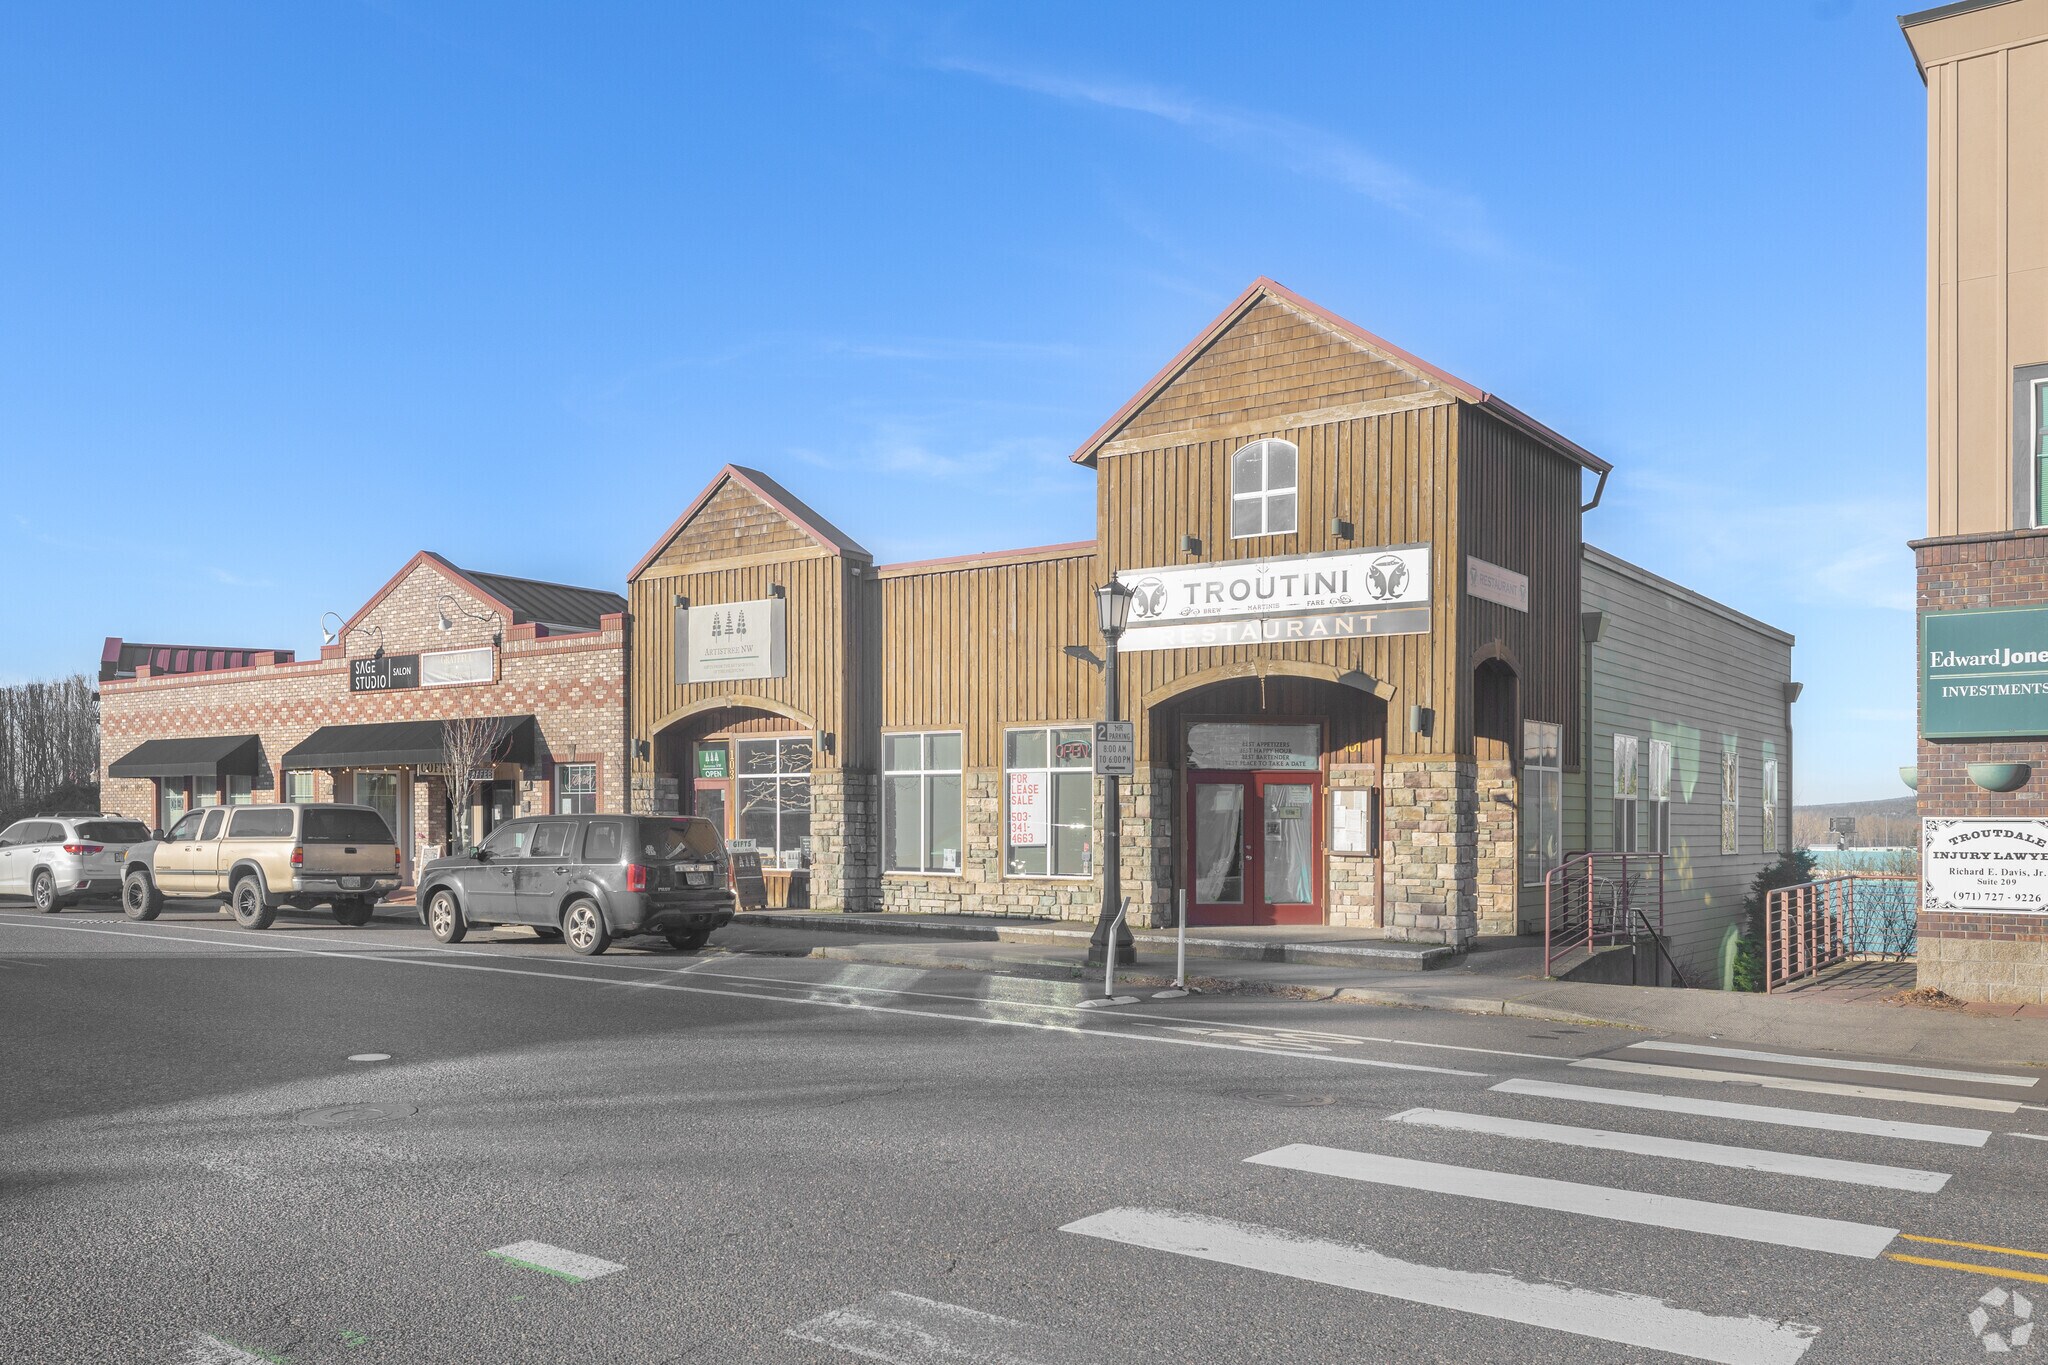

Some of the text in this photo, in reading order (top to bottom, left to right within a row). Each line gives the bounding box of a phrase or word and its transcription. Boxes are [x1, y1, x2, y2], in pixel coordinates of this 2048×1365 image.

[1184, 570, 1348, 604] TROUTINI
[1479, 573, 1518, 597] RESTAURANT
[1247, 602, 1280, 611] MARTINIS
[1306, 599, 1325, 607] FARE
[1159, 614, 1378, 646] RESTAURANT
[1930, 648, 2000, 668] Edward
[355, 659, 376, 675] SAGE
[392, 666, 412, 676] SALON
[355, 674, 387, 690] STUDIO
[1097, 725, 1107, 740] 2
[1108, 732, 1131, 740] PARKING
[1056, 744, 1089, 758] OPEN
[1103, 744, 1127, 753] 8:00 AM
[1099, 754, 1131, 763] TO 6:00 PM
[705, 770, 722, 778] OPEN
[1011, 773, 1028, 783] FOR
[1011, 784, 1039, 795] LEASE
[1011, 795, 1033, 805] SALE
[1011, 812, 1032, 822] 503-
[1011, 822, 1030, 832] 341-
[1011, 833, 1034, 843] 4663
[1948, 829, 2047, 848] TROUTDALE
[732, 840, 752, 848] GIFTS
[1933, 851, 1991, 860] INJURY
[1949, 867, 1985, 876] Richard
[1988, 868, 1998, 876] E.
[2033, 868, 2047, 877] Jr.
[1977, 878, 2017, 886] Suite 209
[1953, 891, 1982, 901] (971)
[1985, 892, 2004, 901] 727
[2015, 893, 2042, 903] 9226
